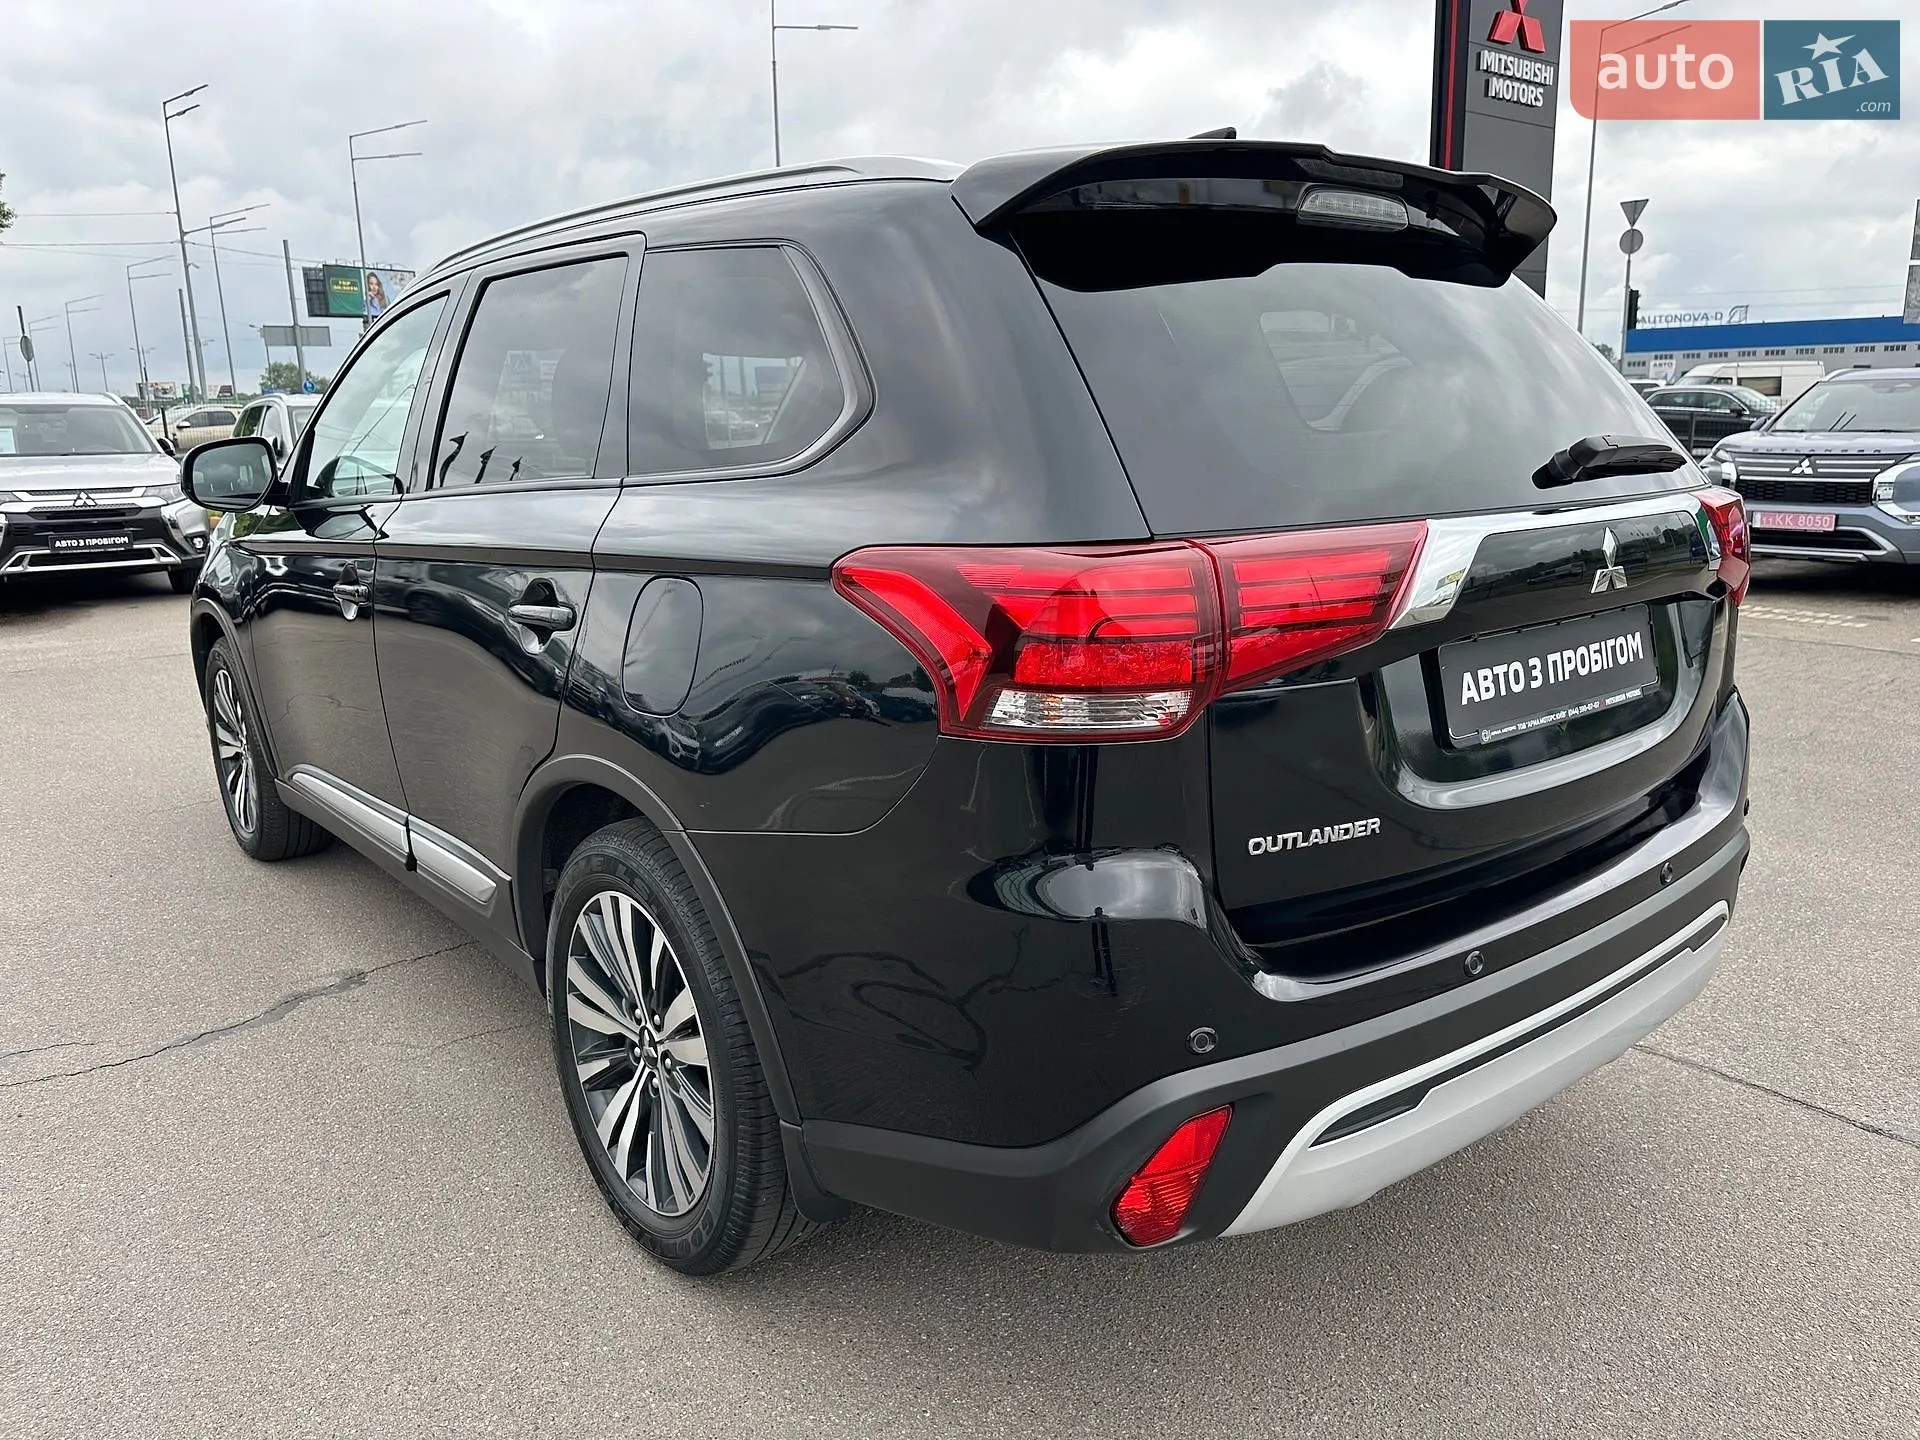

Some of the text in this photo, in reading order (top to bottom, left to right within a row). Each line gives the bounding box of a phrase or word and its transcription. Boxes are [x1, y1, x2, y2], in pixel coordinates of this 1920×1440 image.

[1480, 49, 1554, 86] MITSUBISHI
[1487, 77, 1544, 107] MOTORS
[1639, 311, 1724, 325] AUTONOVA-D
[1798, 514, 1830, 528] 8050
[55, 539, 78, 548] АВТО
[85, 536, 129, 546] ПРОБІГОМ
[1461, 661, 1525, 706] АВТО
[1547, 631, 1644, 685] ПРОБІГОМ
[1248, 817, 1381, 856] OUTLANDER
